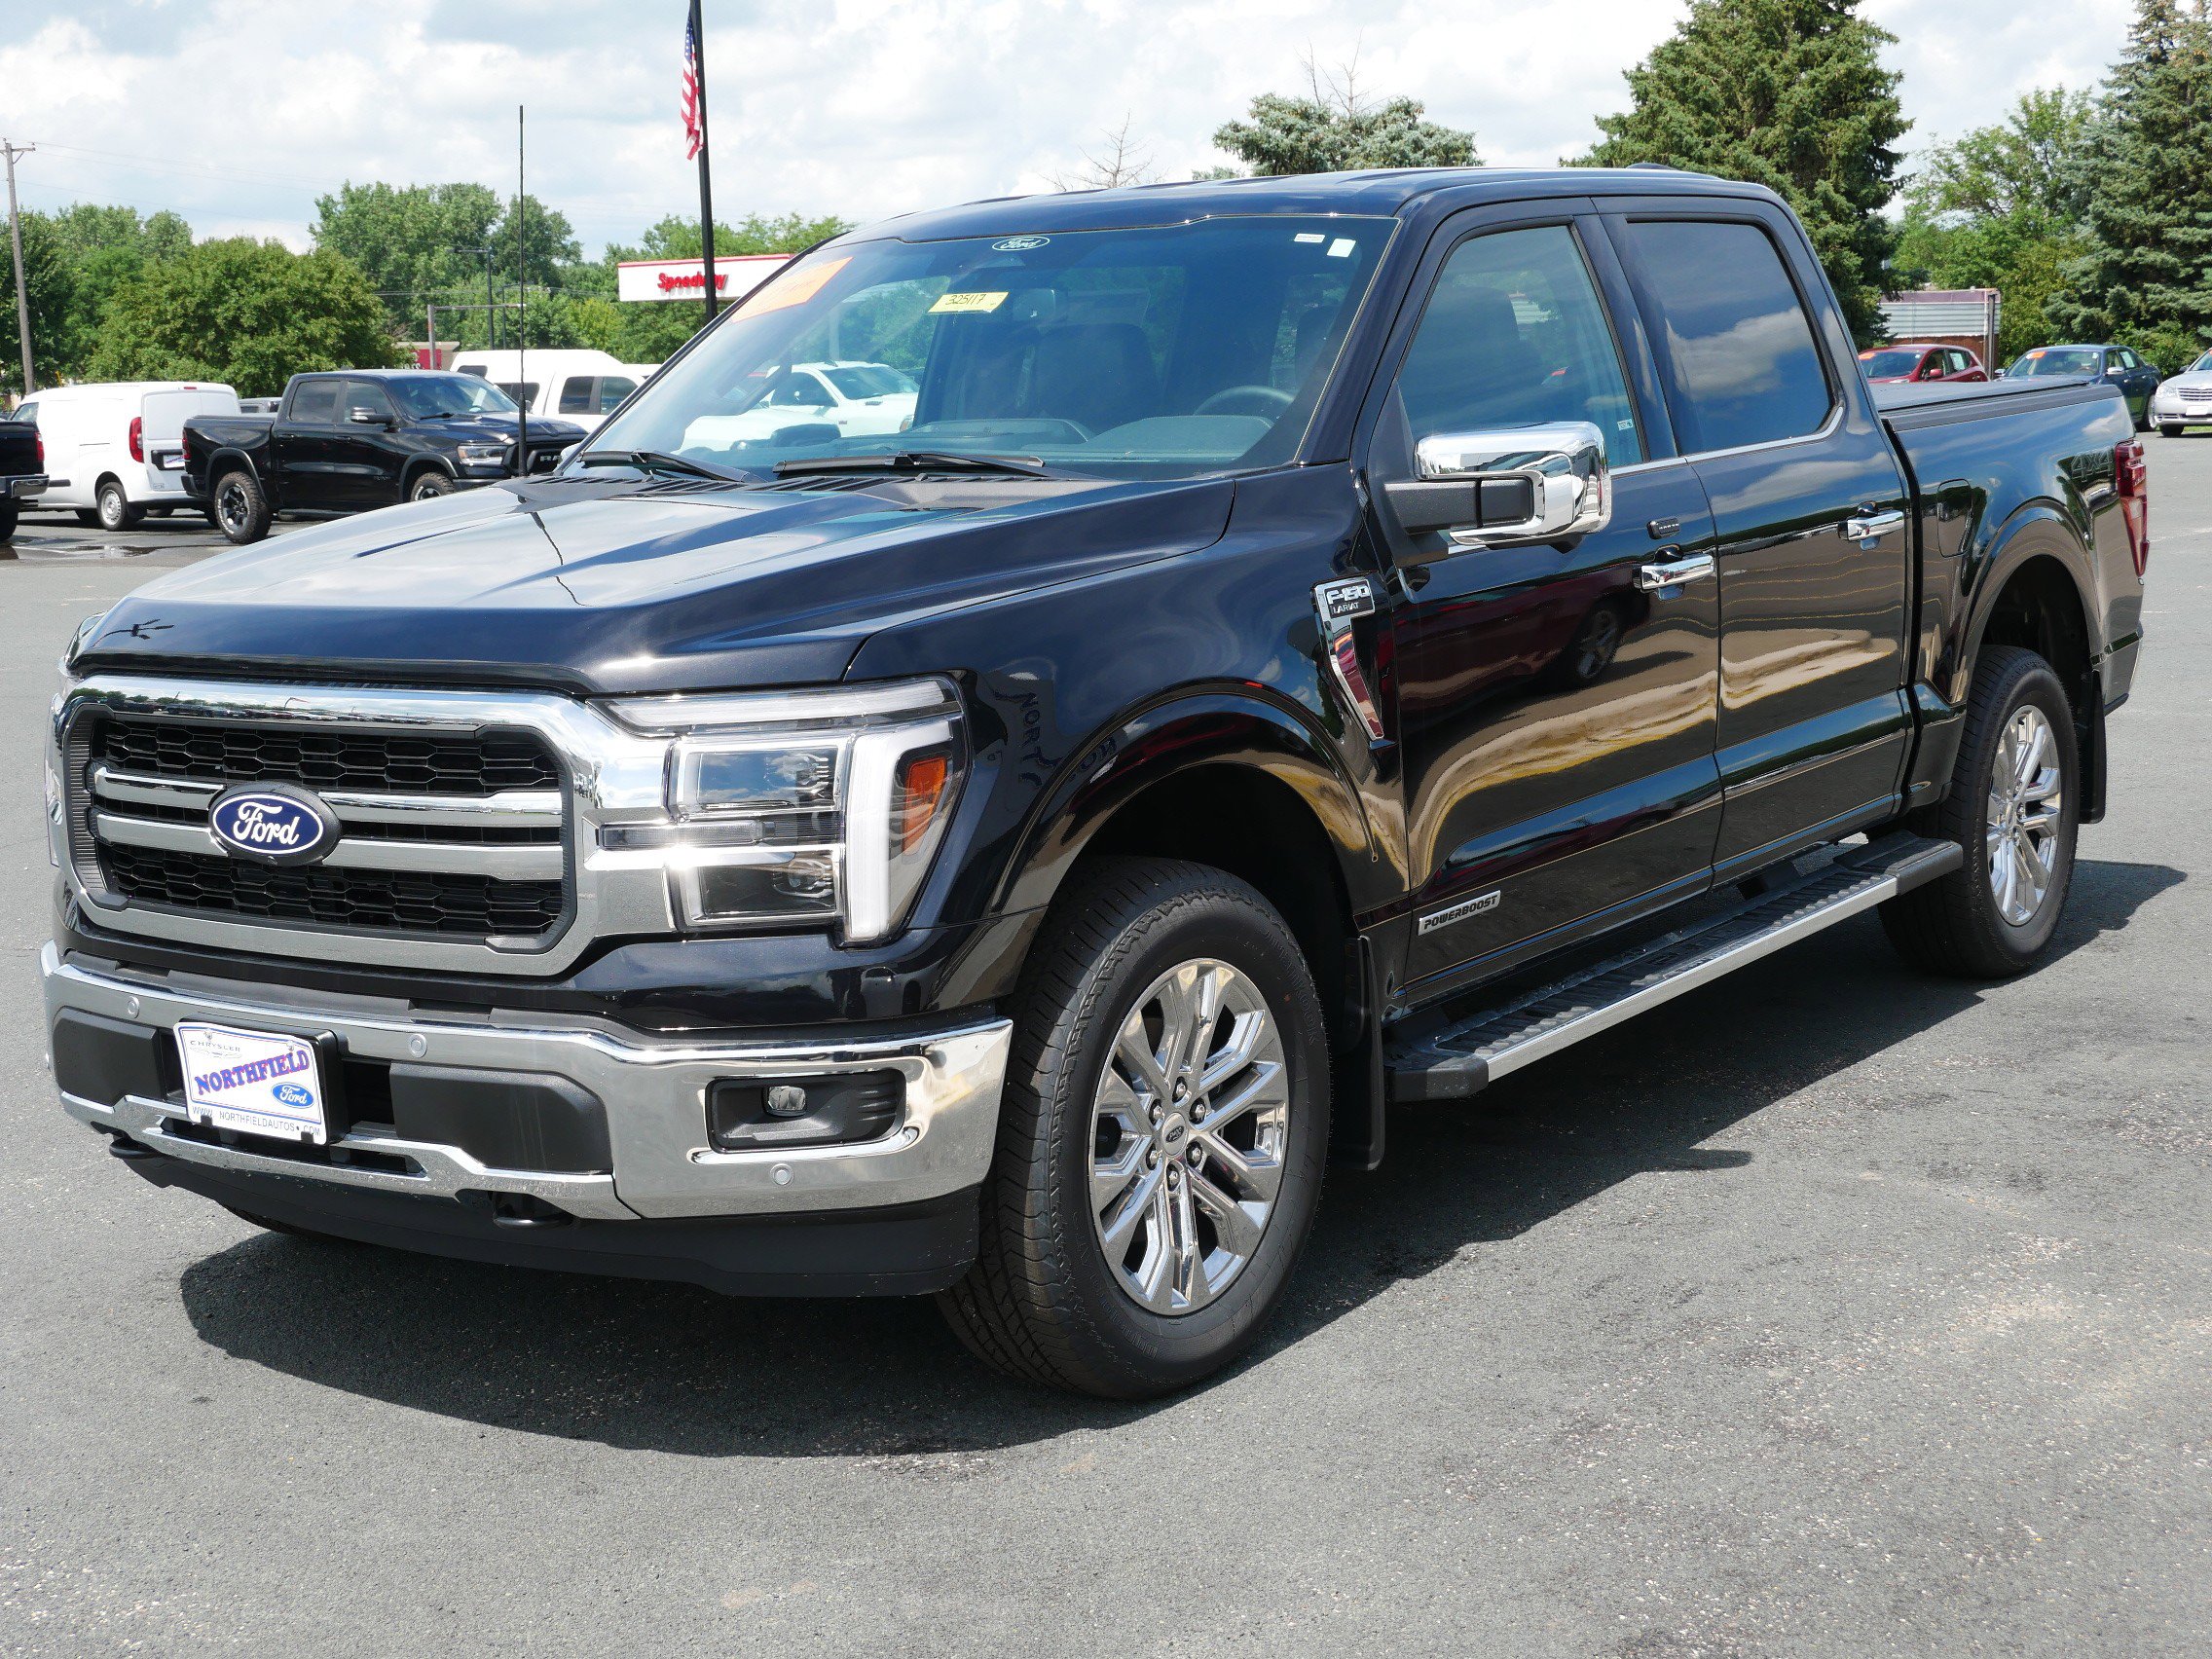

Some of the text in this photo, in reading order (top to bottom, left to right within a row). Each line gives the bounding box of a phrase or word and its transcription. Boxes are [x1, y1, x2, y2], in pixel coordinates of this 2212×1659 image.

[1000, 236, 1042, 249] Ford
[1326, 584, 1371, 605] F-150
[1333, 601, 1360, 614] LARIAT
[233, 801, 301, 846] Ford
[1423, 895, 1498, 930] POWERBOOST
[190, 1040, 241, 1052] CHRYSLER
[194, 1050, 311, 1096] NORTHFIELD
[279, 1085, 308, 1105] Ford
